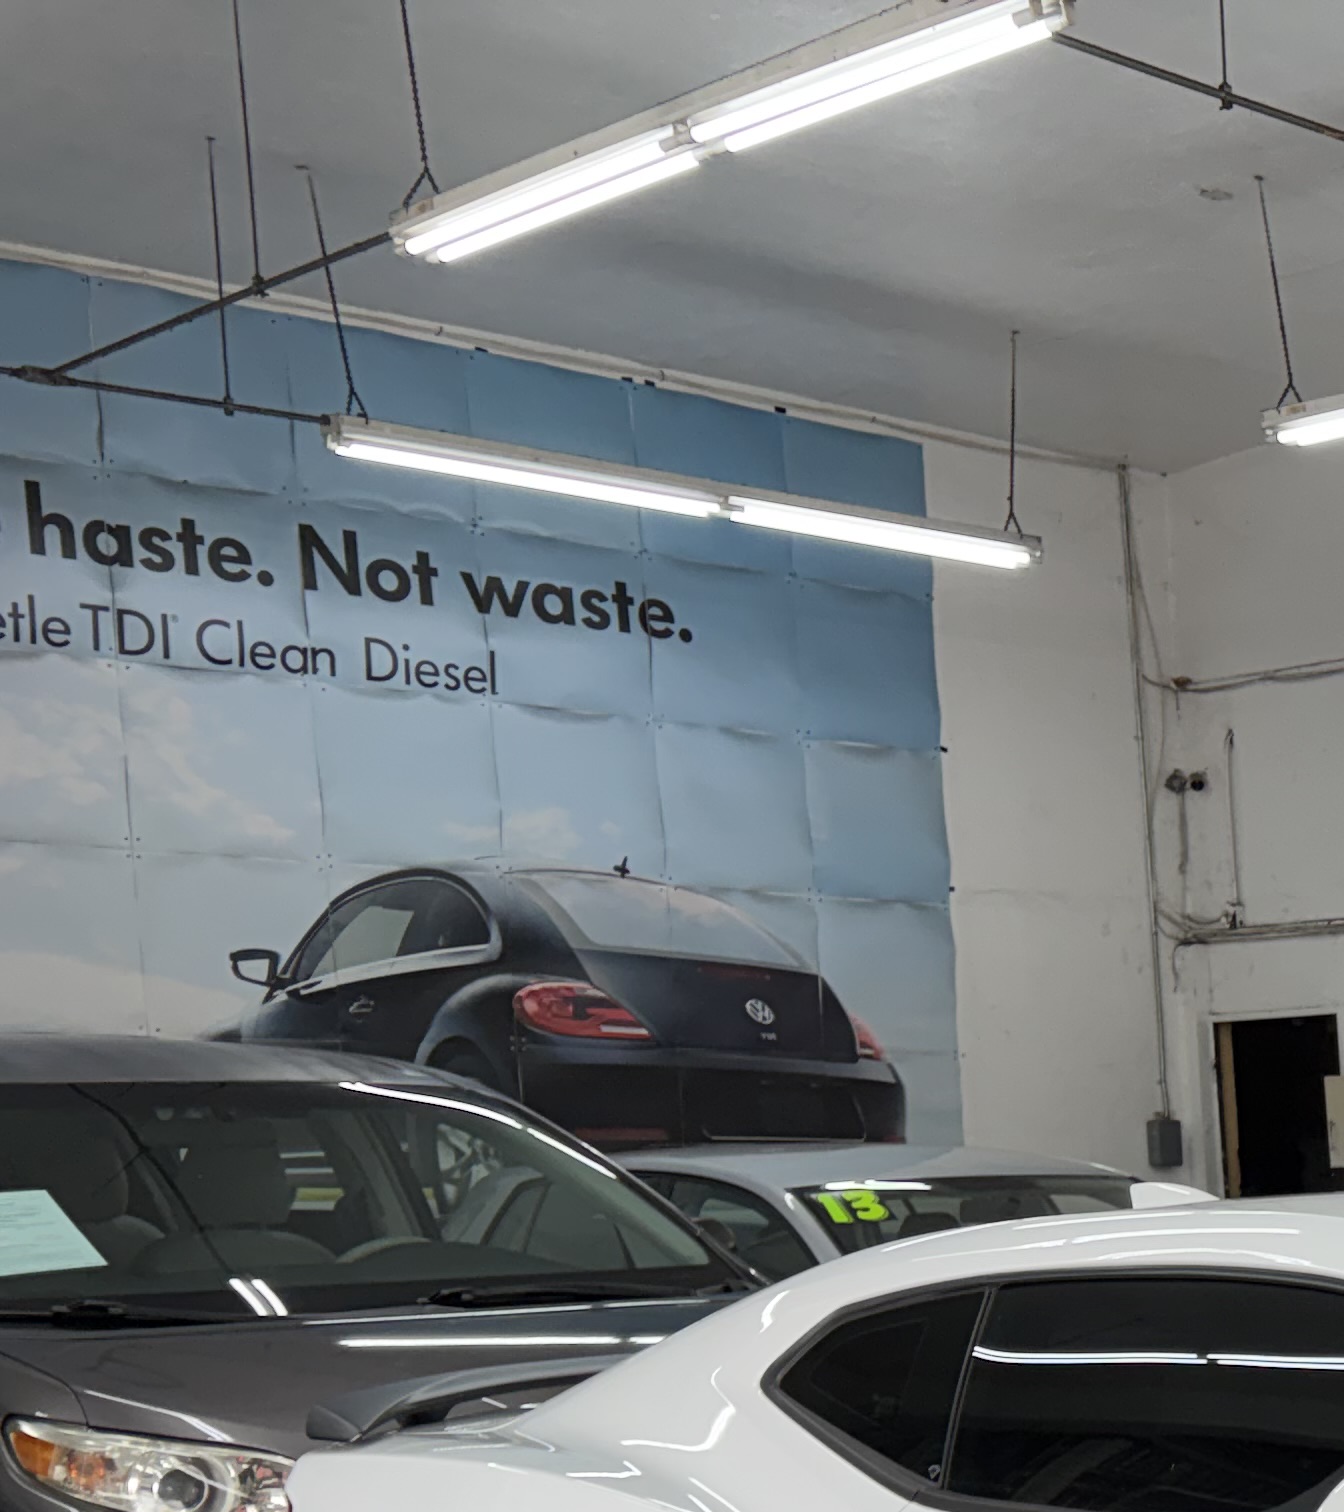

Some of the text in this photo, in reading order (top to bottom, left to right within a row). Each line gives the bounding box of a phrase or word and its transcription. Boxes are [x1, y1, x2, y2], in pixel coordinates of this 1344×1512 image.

[24, 480, 694, 643] haste. Not waste.
[196, 618, 337, 678] Clean
[363, 636, 500, 696] Diesel
[816, 1189, 890, 1224] 13
